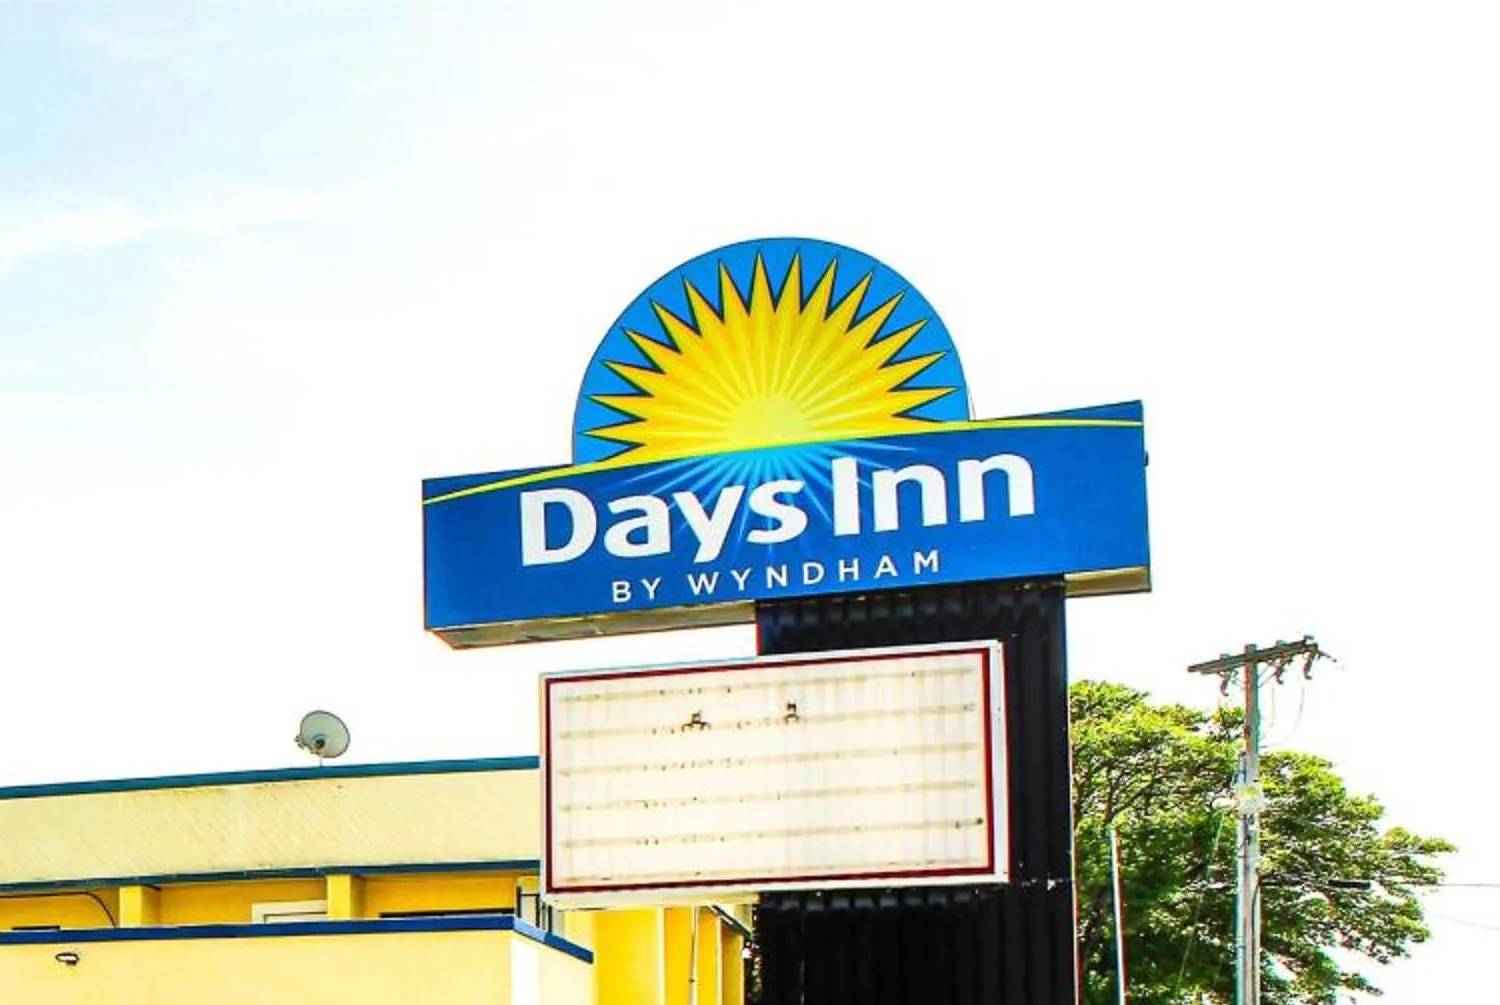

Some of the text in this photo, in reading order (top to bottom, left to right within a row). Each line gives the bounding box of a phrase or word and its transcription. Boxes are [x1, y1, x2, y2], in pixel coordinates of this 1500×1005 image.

[520, 453, 1035, 566] Days Inn
[611, 550, 940, 603] BY WYNDHAM
